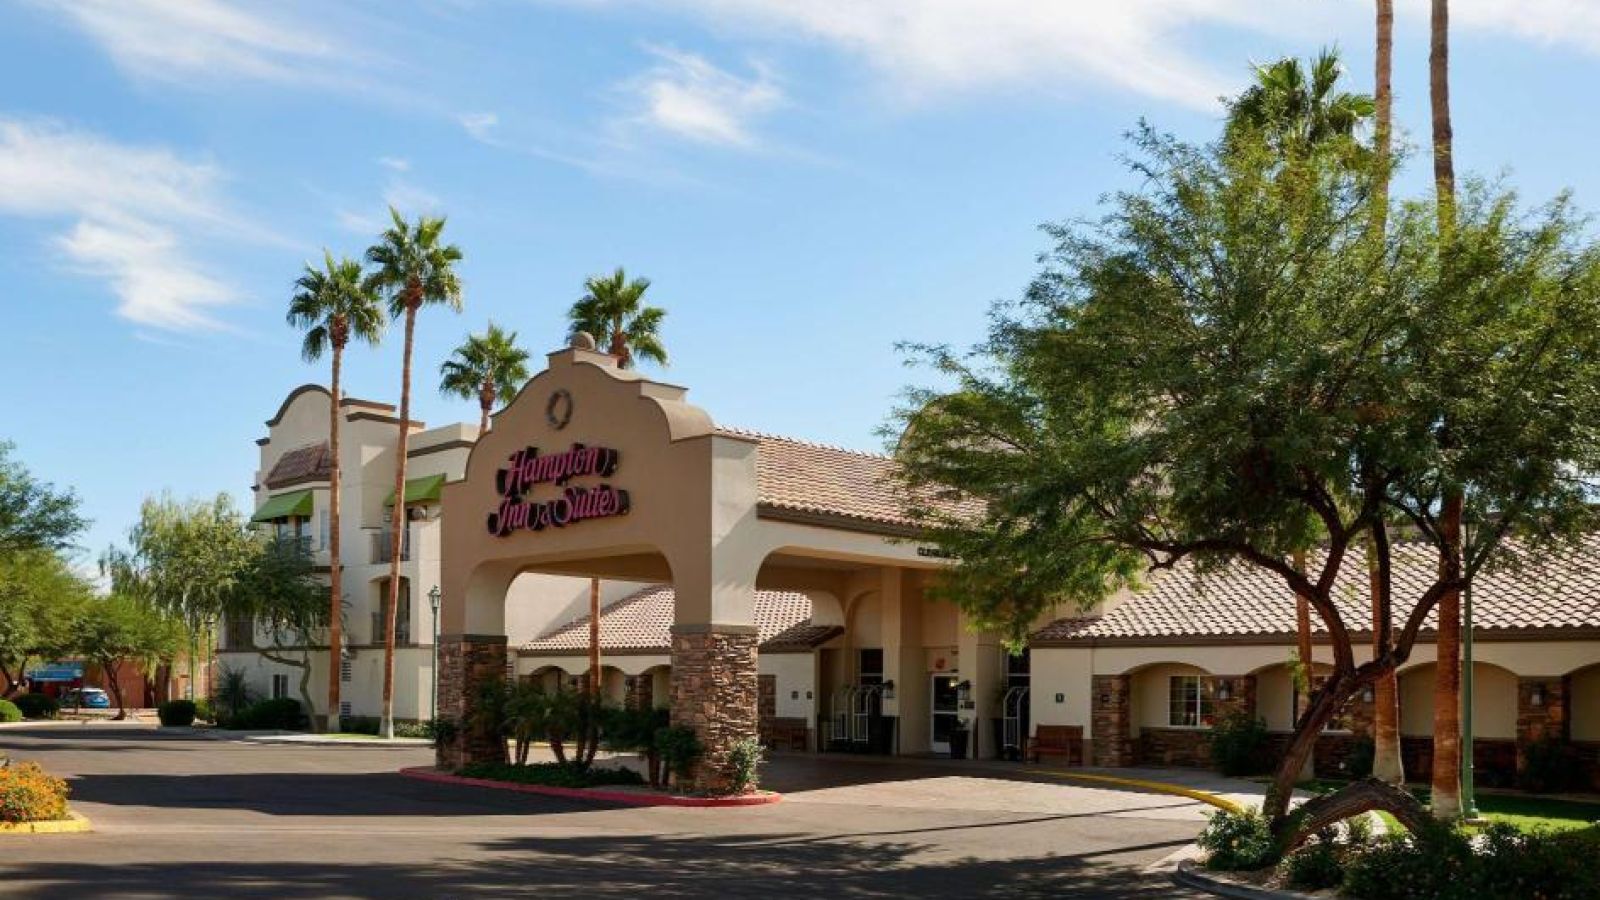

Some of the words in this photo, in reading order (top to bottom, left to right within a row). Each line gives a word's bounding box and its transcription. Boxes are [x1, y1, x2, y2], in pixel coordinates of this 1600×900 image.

[497, 443, 617, 496] Hampton
[488, 496, 542, 536] Inn
[551, 484, 629, 527] Suites
